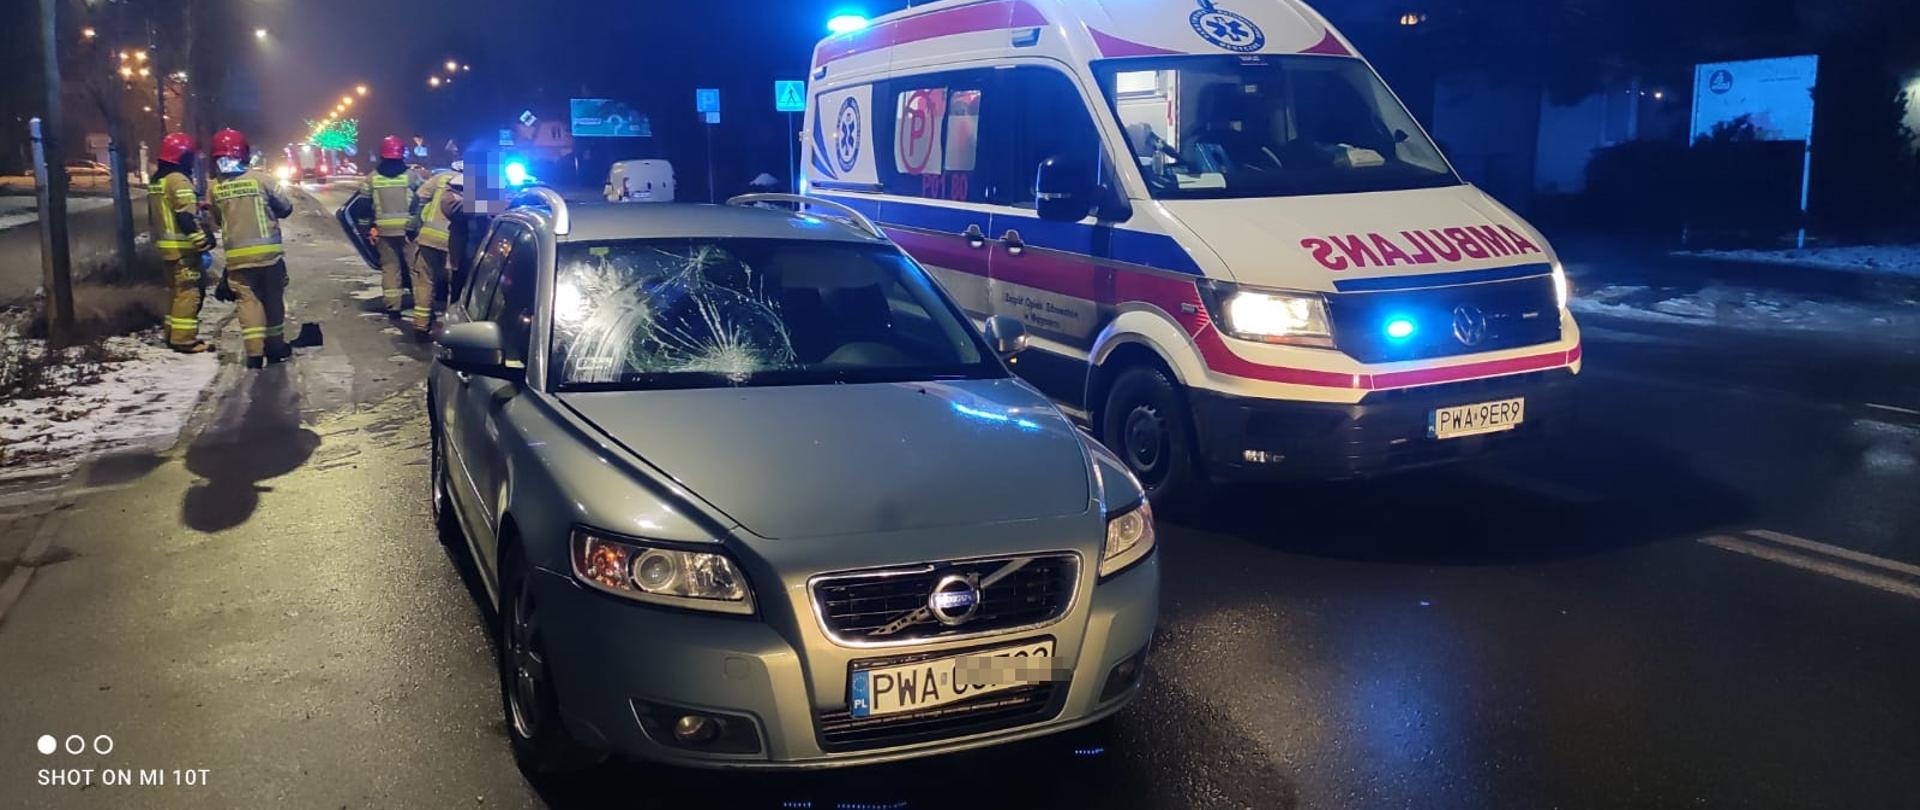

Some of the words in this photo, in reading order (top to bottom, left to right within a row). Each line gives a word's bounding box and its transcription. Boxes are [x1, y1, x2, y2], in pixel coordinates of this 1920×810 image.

[1440, 408, 1473, 432] PWA
[1480, 401, 1520, 426] 9ER9
[854, 699, 868, 708] PL
[873, 667, 939, 709] PWA
